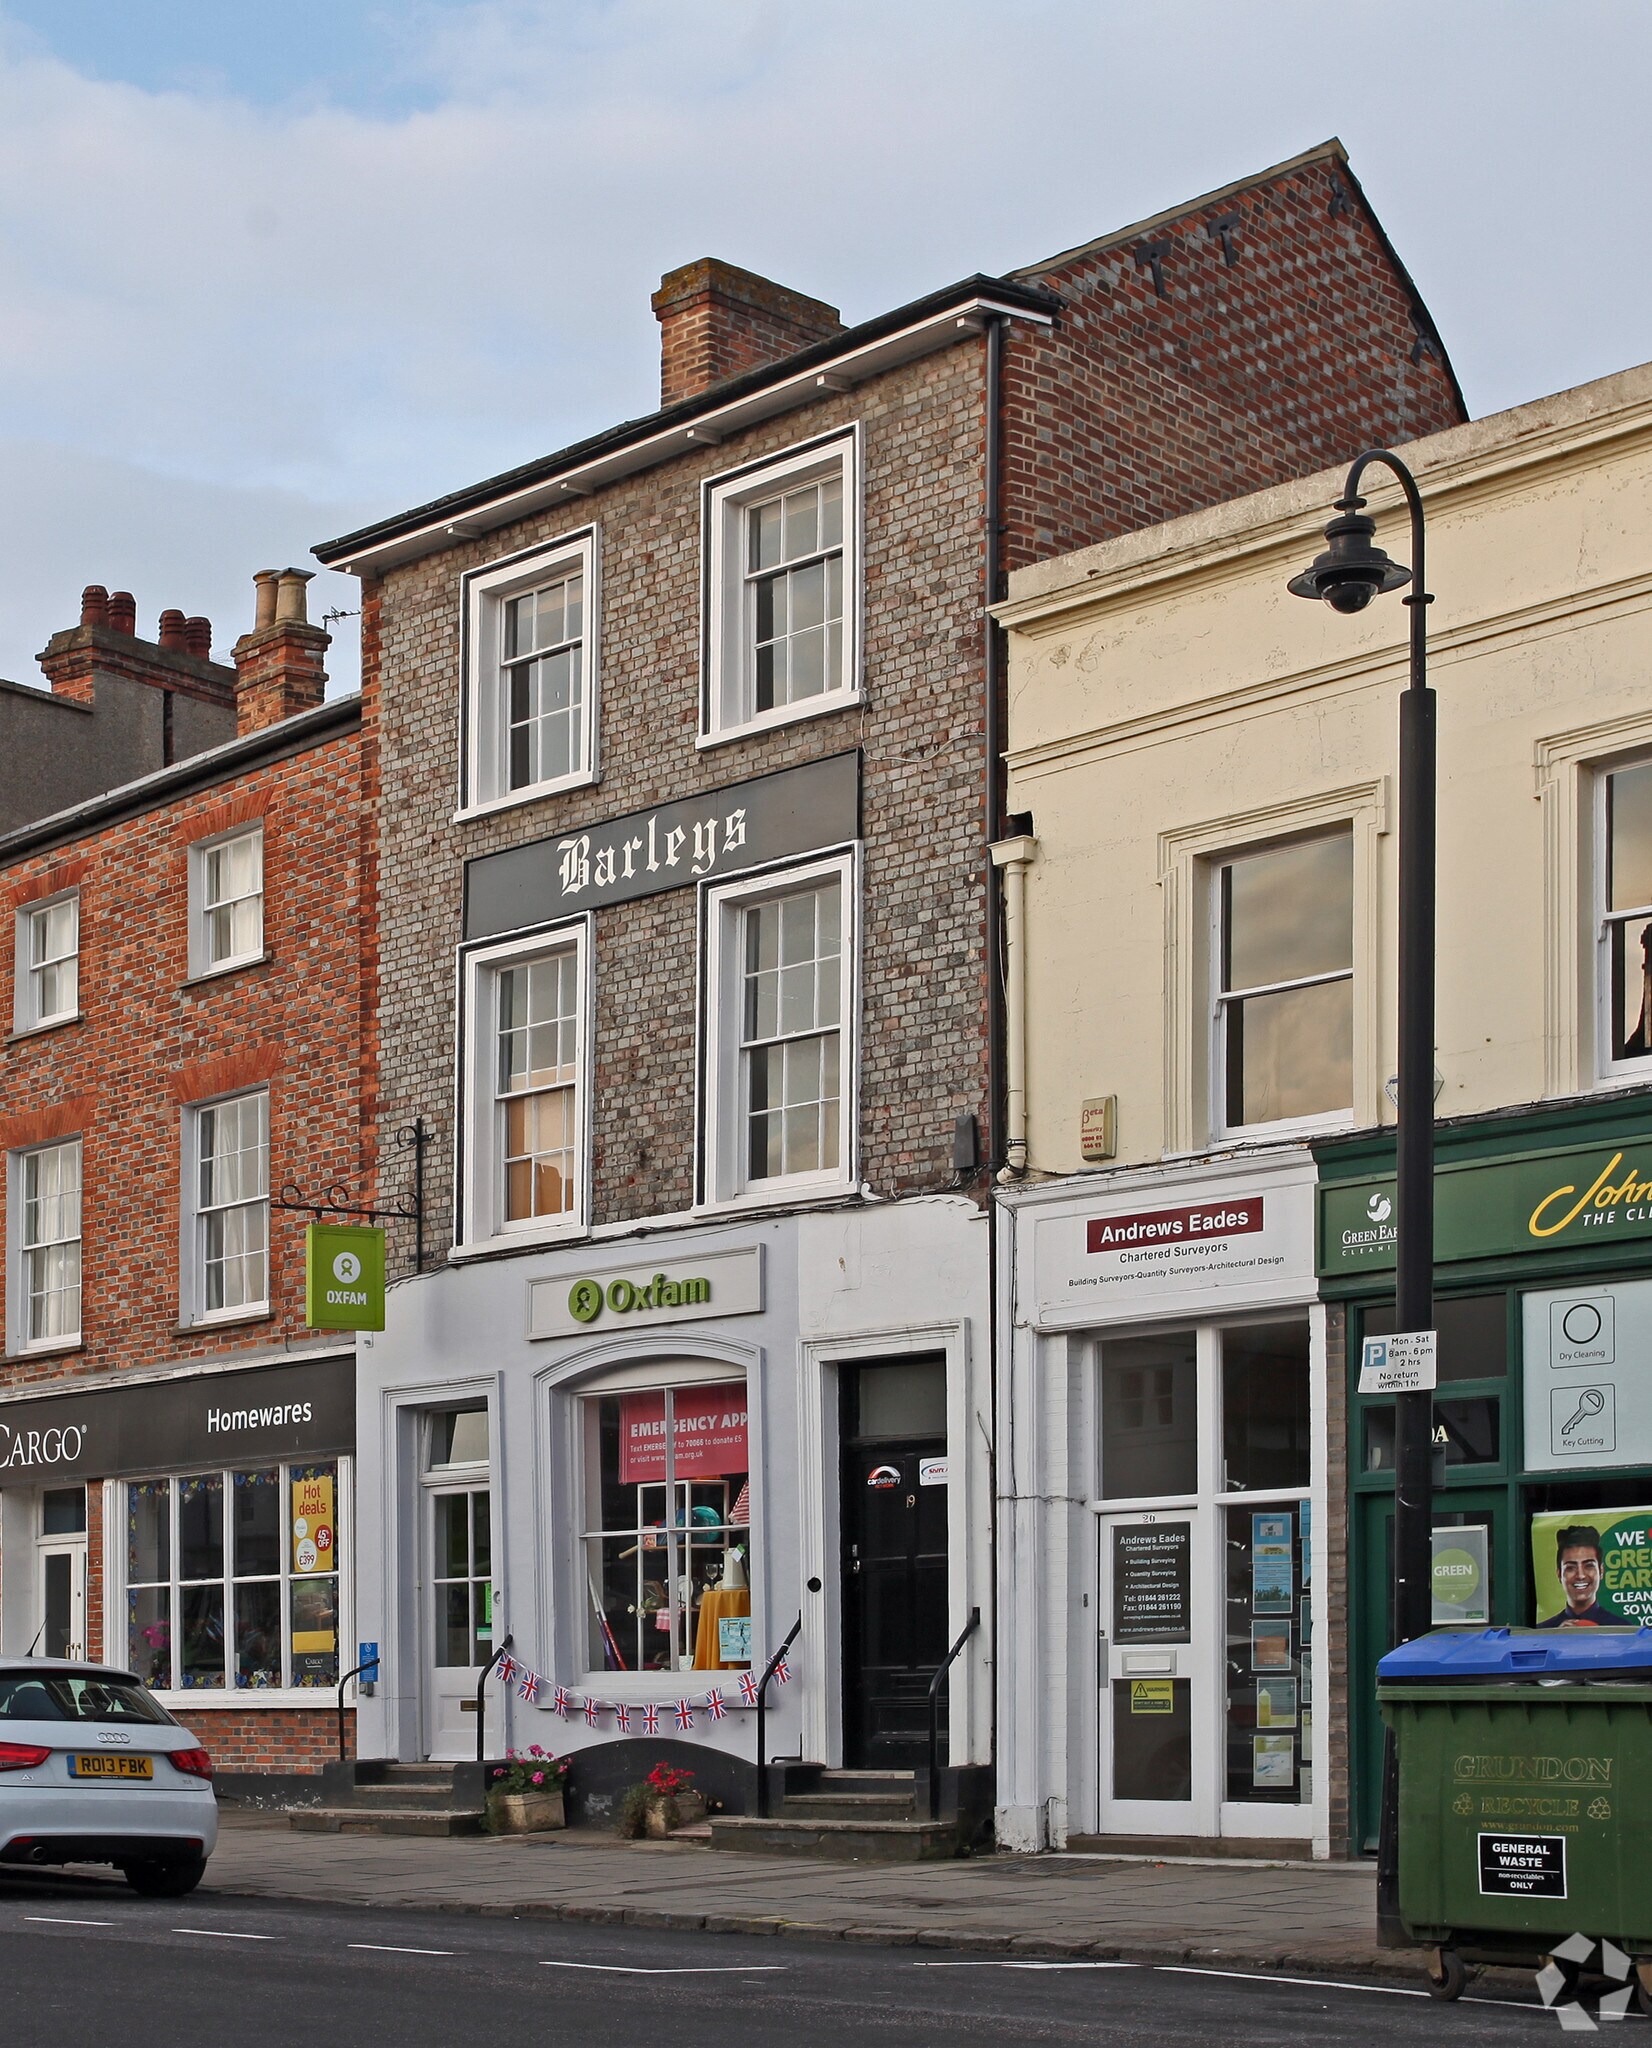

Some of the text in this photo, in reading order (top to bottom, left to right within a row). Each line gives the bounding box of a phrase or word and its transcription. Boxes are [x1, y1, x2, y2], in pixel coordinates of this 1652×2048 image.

[557, 809, 747, 897] Barleys
[1583, 1211, 1616, 1226] THE
[1100, 1210, 1249, 1244] Andrews Eades
[1119, 1242, 1228, 1264] Chartered Surveyors
[1068, 1278, 1098, 1287] Building
[1257, 1256, 1285, 1265] Design
[326, 1290, 367, 1305] OXFAM
[606, 1273, 710, 1313] Oxfam
[1391, 1337, 1409, 1346] Mon
[1415, 1335, 1430, 1344] Sat
[1369, 1345, 1383, 1366] P
[1388, 1348, 1408, 1358] 8am
[1559, 1350, 1606, 1361] Dry Cleaning
[1400, 1359, 1406, 1367] 2
[1379, 1371, 1419, 1380] No return
[207, 1401, 313, 1433] Homewares
[630, 1411, 748, 1438] EMERGENCY APP
[630, 1445, 643, 1453] Text
[643, 1442, 677, 1452] EMERGEY
[678, 1441, 685, 1449] to
[704, 1438, 712, 1446] to
[712, 1435, 734, 1444] donate
[734, 1434, 743, 1442] £5
[1562, 1436, 1604, 1448] Key Cutting
[651, 1451, 704, 1462] www.am.org.uk
[303, 1484, 321, 1500] Hot
[298, 1499, 327, 1516] deals
[906, 1494, 916, 1509] 19
[1142, 1513, 1156, 1524] 20
[317, 1538, 330, 1548] OFF
[1120, 1533, 1186, 1545] Andrews Eades
[1614, 1530, 1646, 1547] WE
[299, 1554, 315, 1566] £399
[1151, 1557, 1176, 1565] Surveying
[1604, 1548, 1652, 1570] GRE
[1151, 1569, 1177, 1577] Surveying
[1433, 1564, 1473, 1577] GREEN
[1129, 1581, 1180, 1590] Architectural Design
[1604, 1569, 1652, 1590] EAR
[1137, 1594, 1157, 1602] 01844
[1157, 1593, 1181, 1601] 261222
[1138, 1603, 1157, 1611] 01844
[1622, 1604, 1640, 1615] SO
[119, 1758, 147, 1774] FBK
[1454, 1755, 1613, 1781] GRUNDON
[1480, 1796, 1580, 1817] RECYCLE
[1480, 1820, 1580, 1833] www.grundon.com
[1492, 1842, 1551, 1855] GENERAL
[1499, 1856, 1543, 1867] WASTE
[1498, 1872, 1545, 1881] non-recyclables
[1510, 1881, 1534, 1889] ONLY
